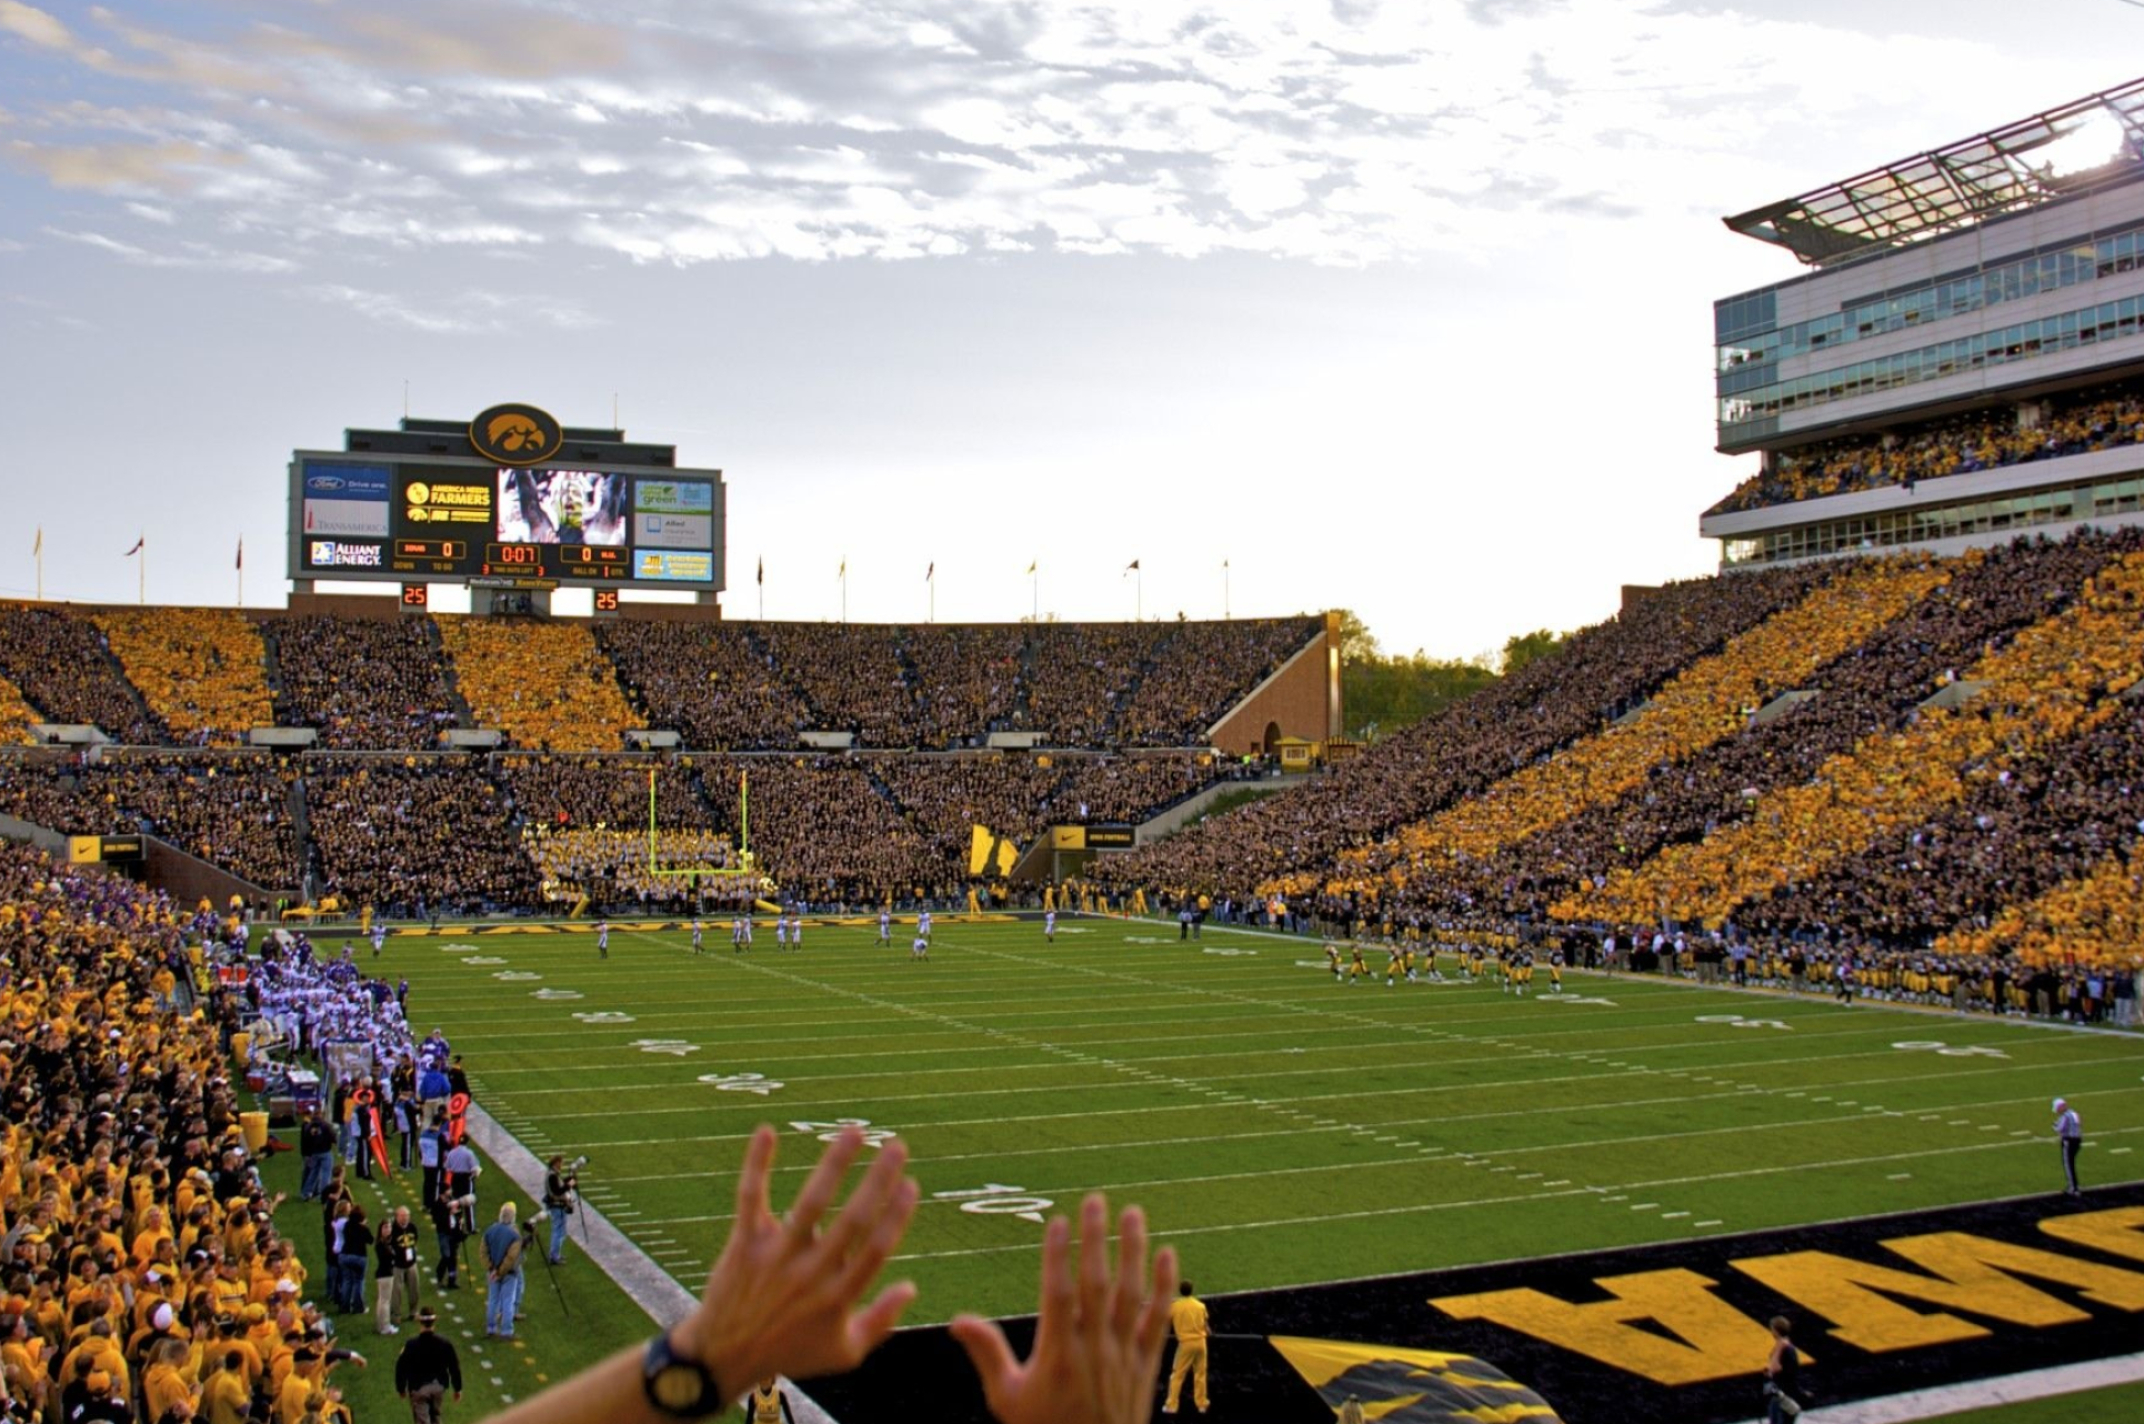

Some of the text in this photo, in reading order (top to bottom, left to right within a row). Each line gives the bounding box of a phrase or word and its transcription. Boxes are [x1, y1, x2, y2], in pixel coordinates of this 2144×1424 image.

[315, 478, 339, 490] Ford
[430, 492, 490, 505] FARMERS
[335, 543, 381, 555] ALLIANT
[442, 542, 452, 557] 0
[582, 547, 592, 562] 0
[404, 587, 425, 604] 25
[596, 593, 617, 610] 25
